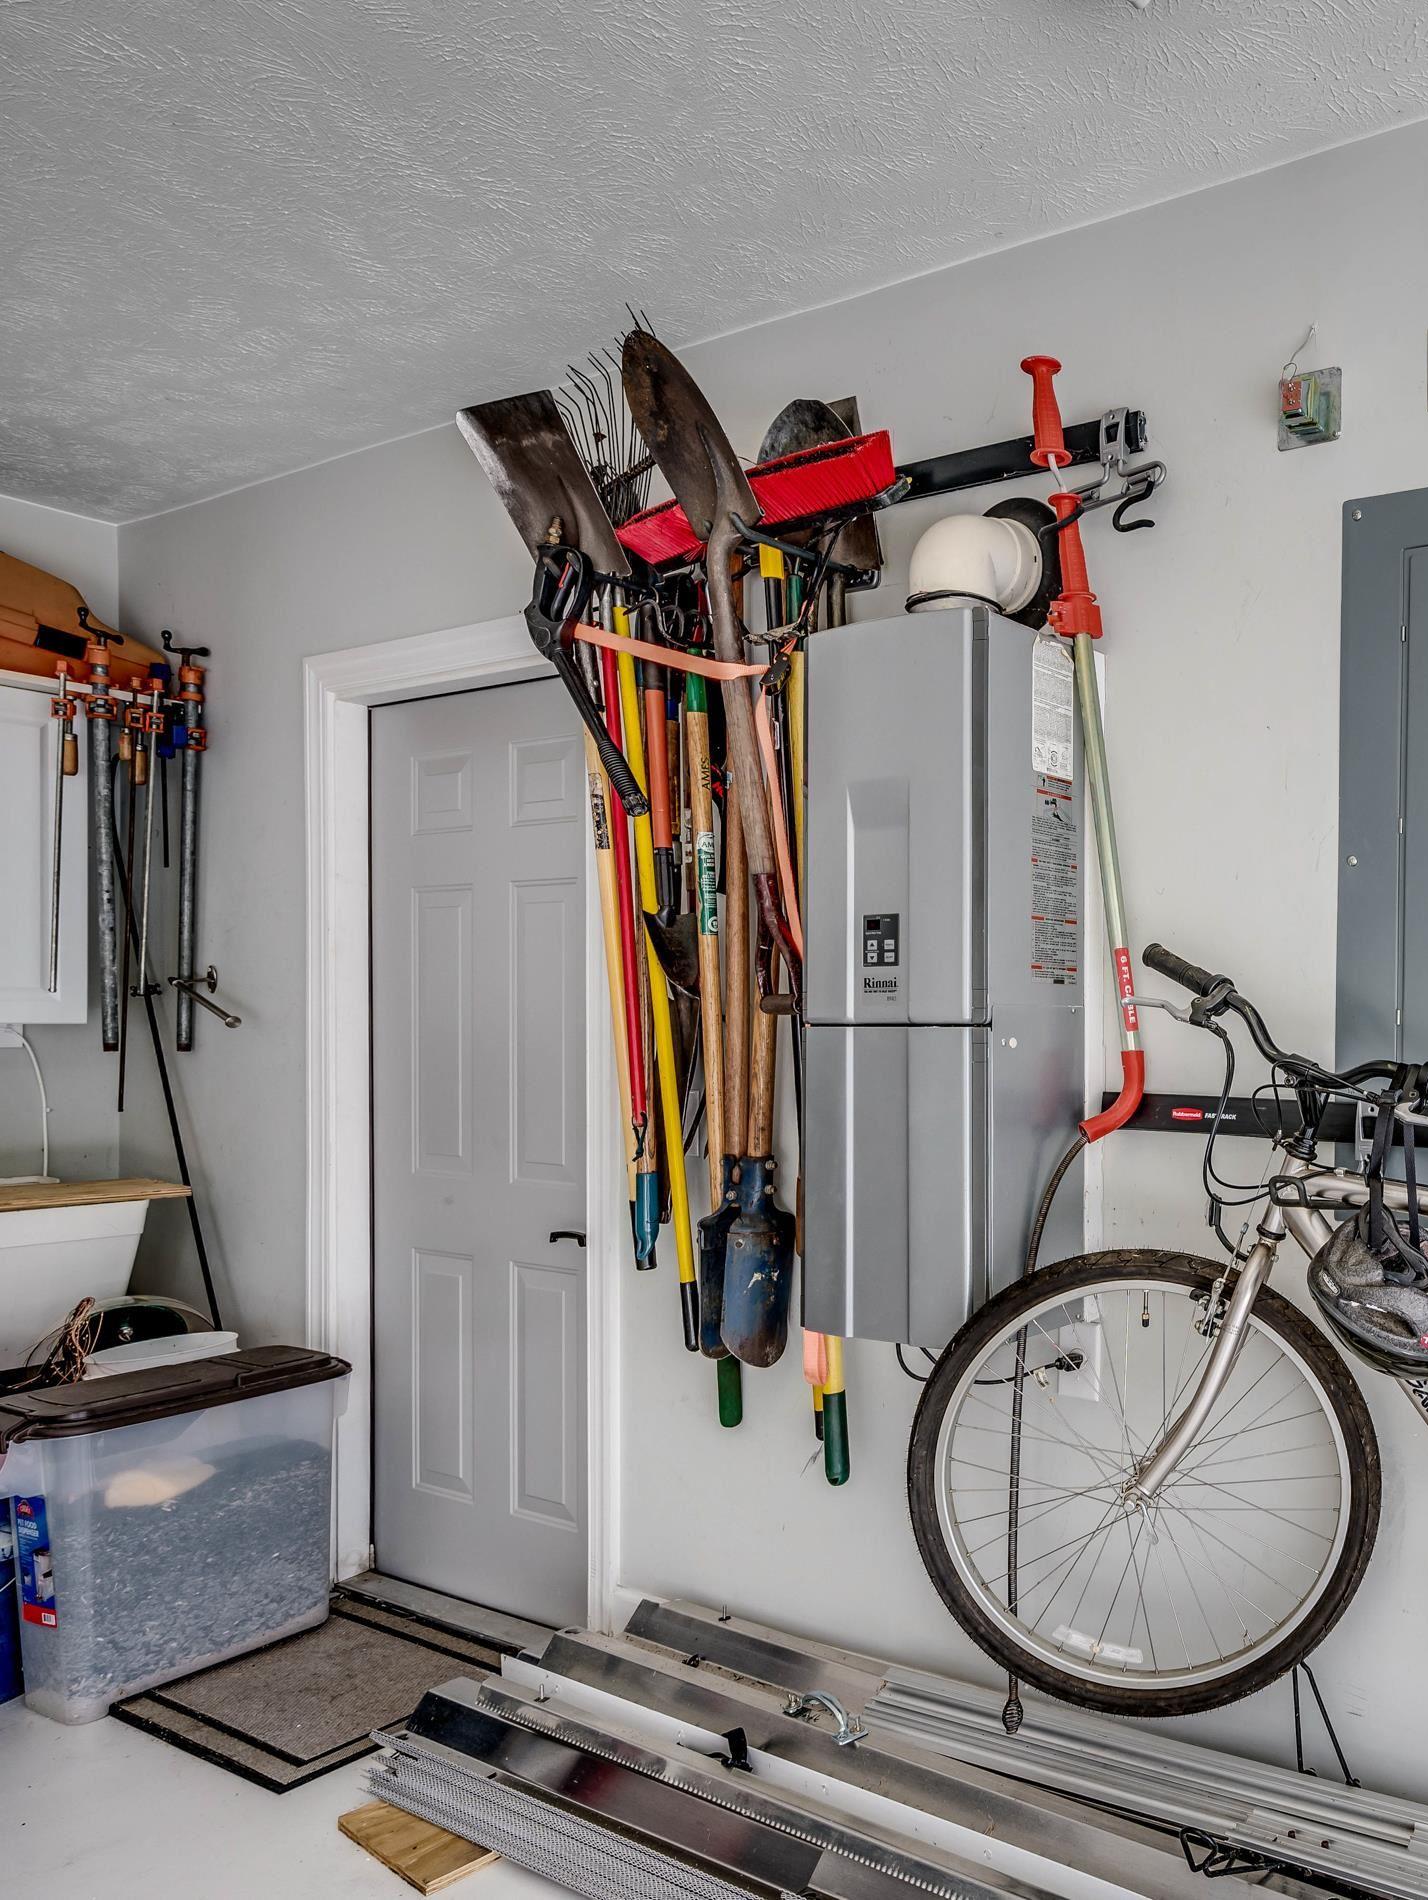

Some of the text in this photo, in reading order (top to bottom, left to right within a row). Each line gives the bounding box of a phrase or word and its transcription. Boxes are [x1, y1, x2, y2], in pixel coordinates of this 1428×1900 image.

[701, 757, 711, 791] AMES
[1120, 955, 1128, 963] 6
[1121, 966, 1130, 983] FT.
[863, 976, 897, 989] Rinnai
